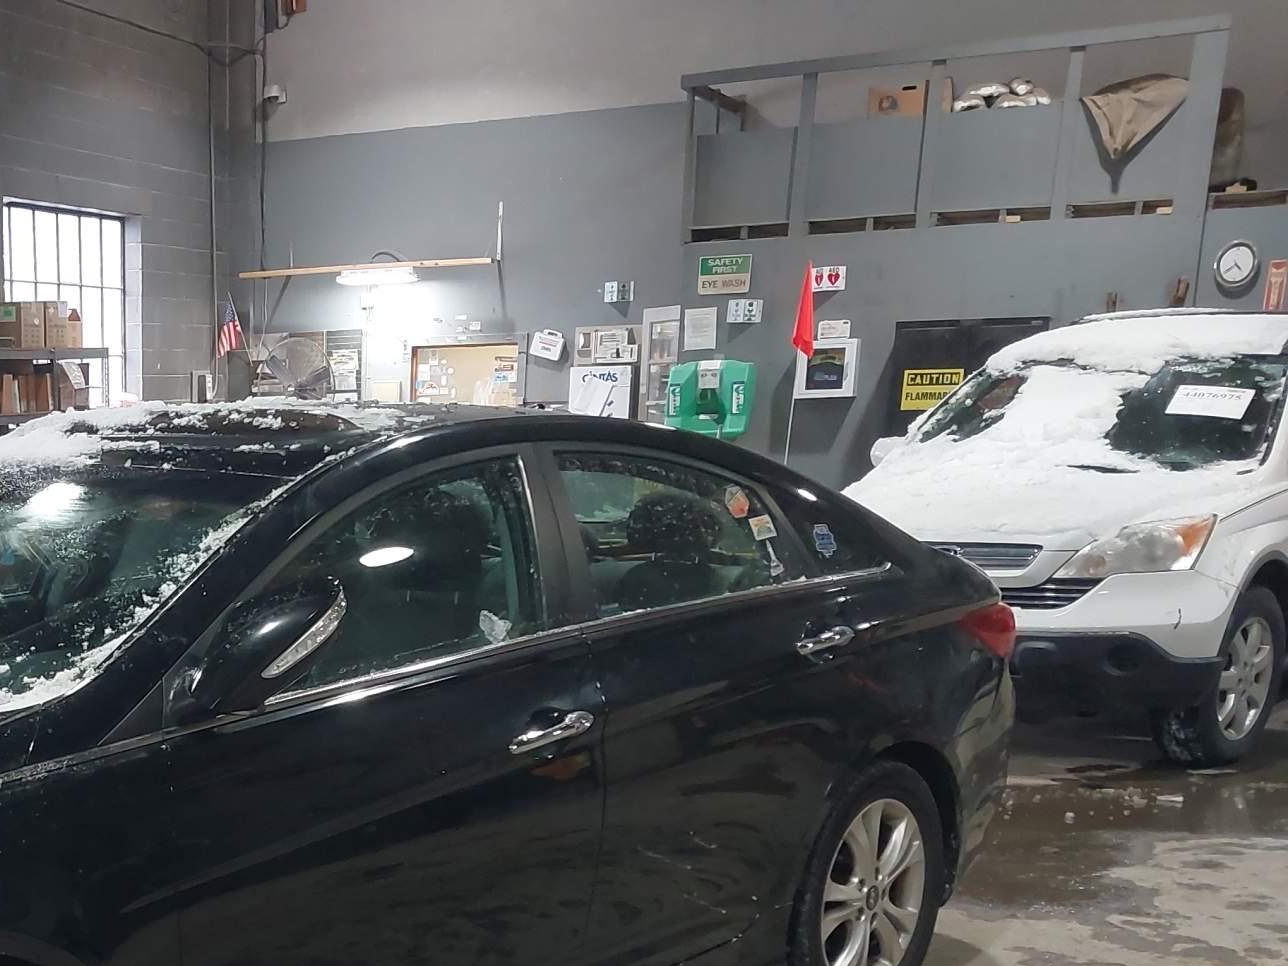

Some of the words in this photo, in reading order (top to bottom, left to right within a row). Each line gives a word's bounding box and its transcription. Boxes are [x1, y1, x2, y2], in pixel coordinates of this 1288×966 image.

[708, 258, 743, 266] SAFETY
[712, 266, 737, 274] FIRST
[702, 280, 719, 288] EYE
[722, 279, 746, 288] WASH
[908, 374, 960, 385] CAUTION
